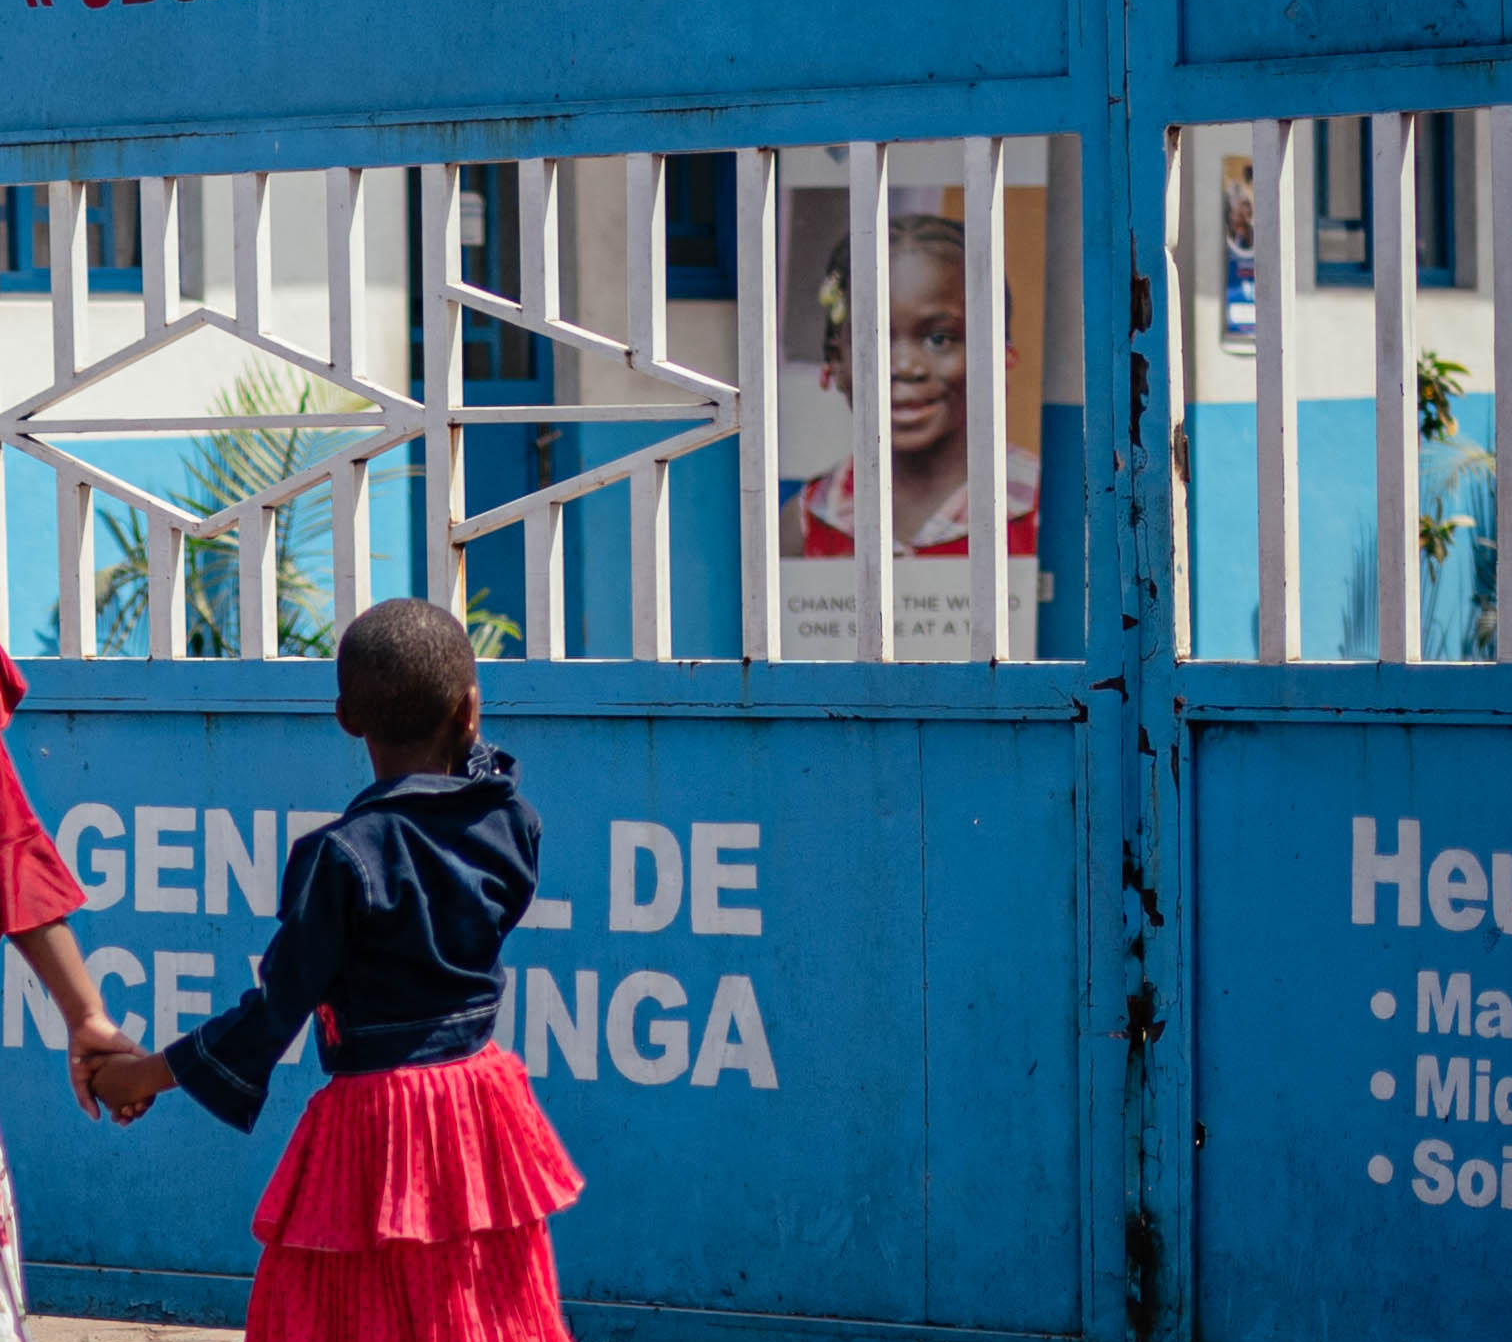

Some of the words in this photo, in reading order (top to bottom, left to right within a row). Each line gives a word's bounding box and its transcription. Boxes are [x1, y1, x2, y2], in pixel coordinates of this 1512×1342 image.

[797, 621, 840, 639] ONE
[912, 621, 937, 636] AT
[609, 819, 763, 937] DE
